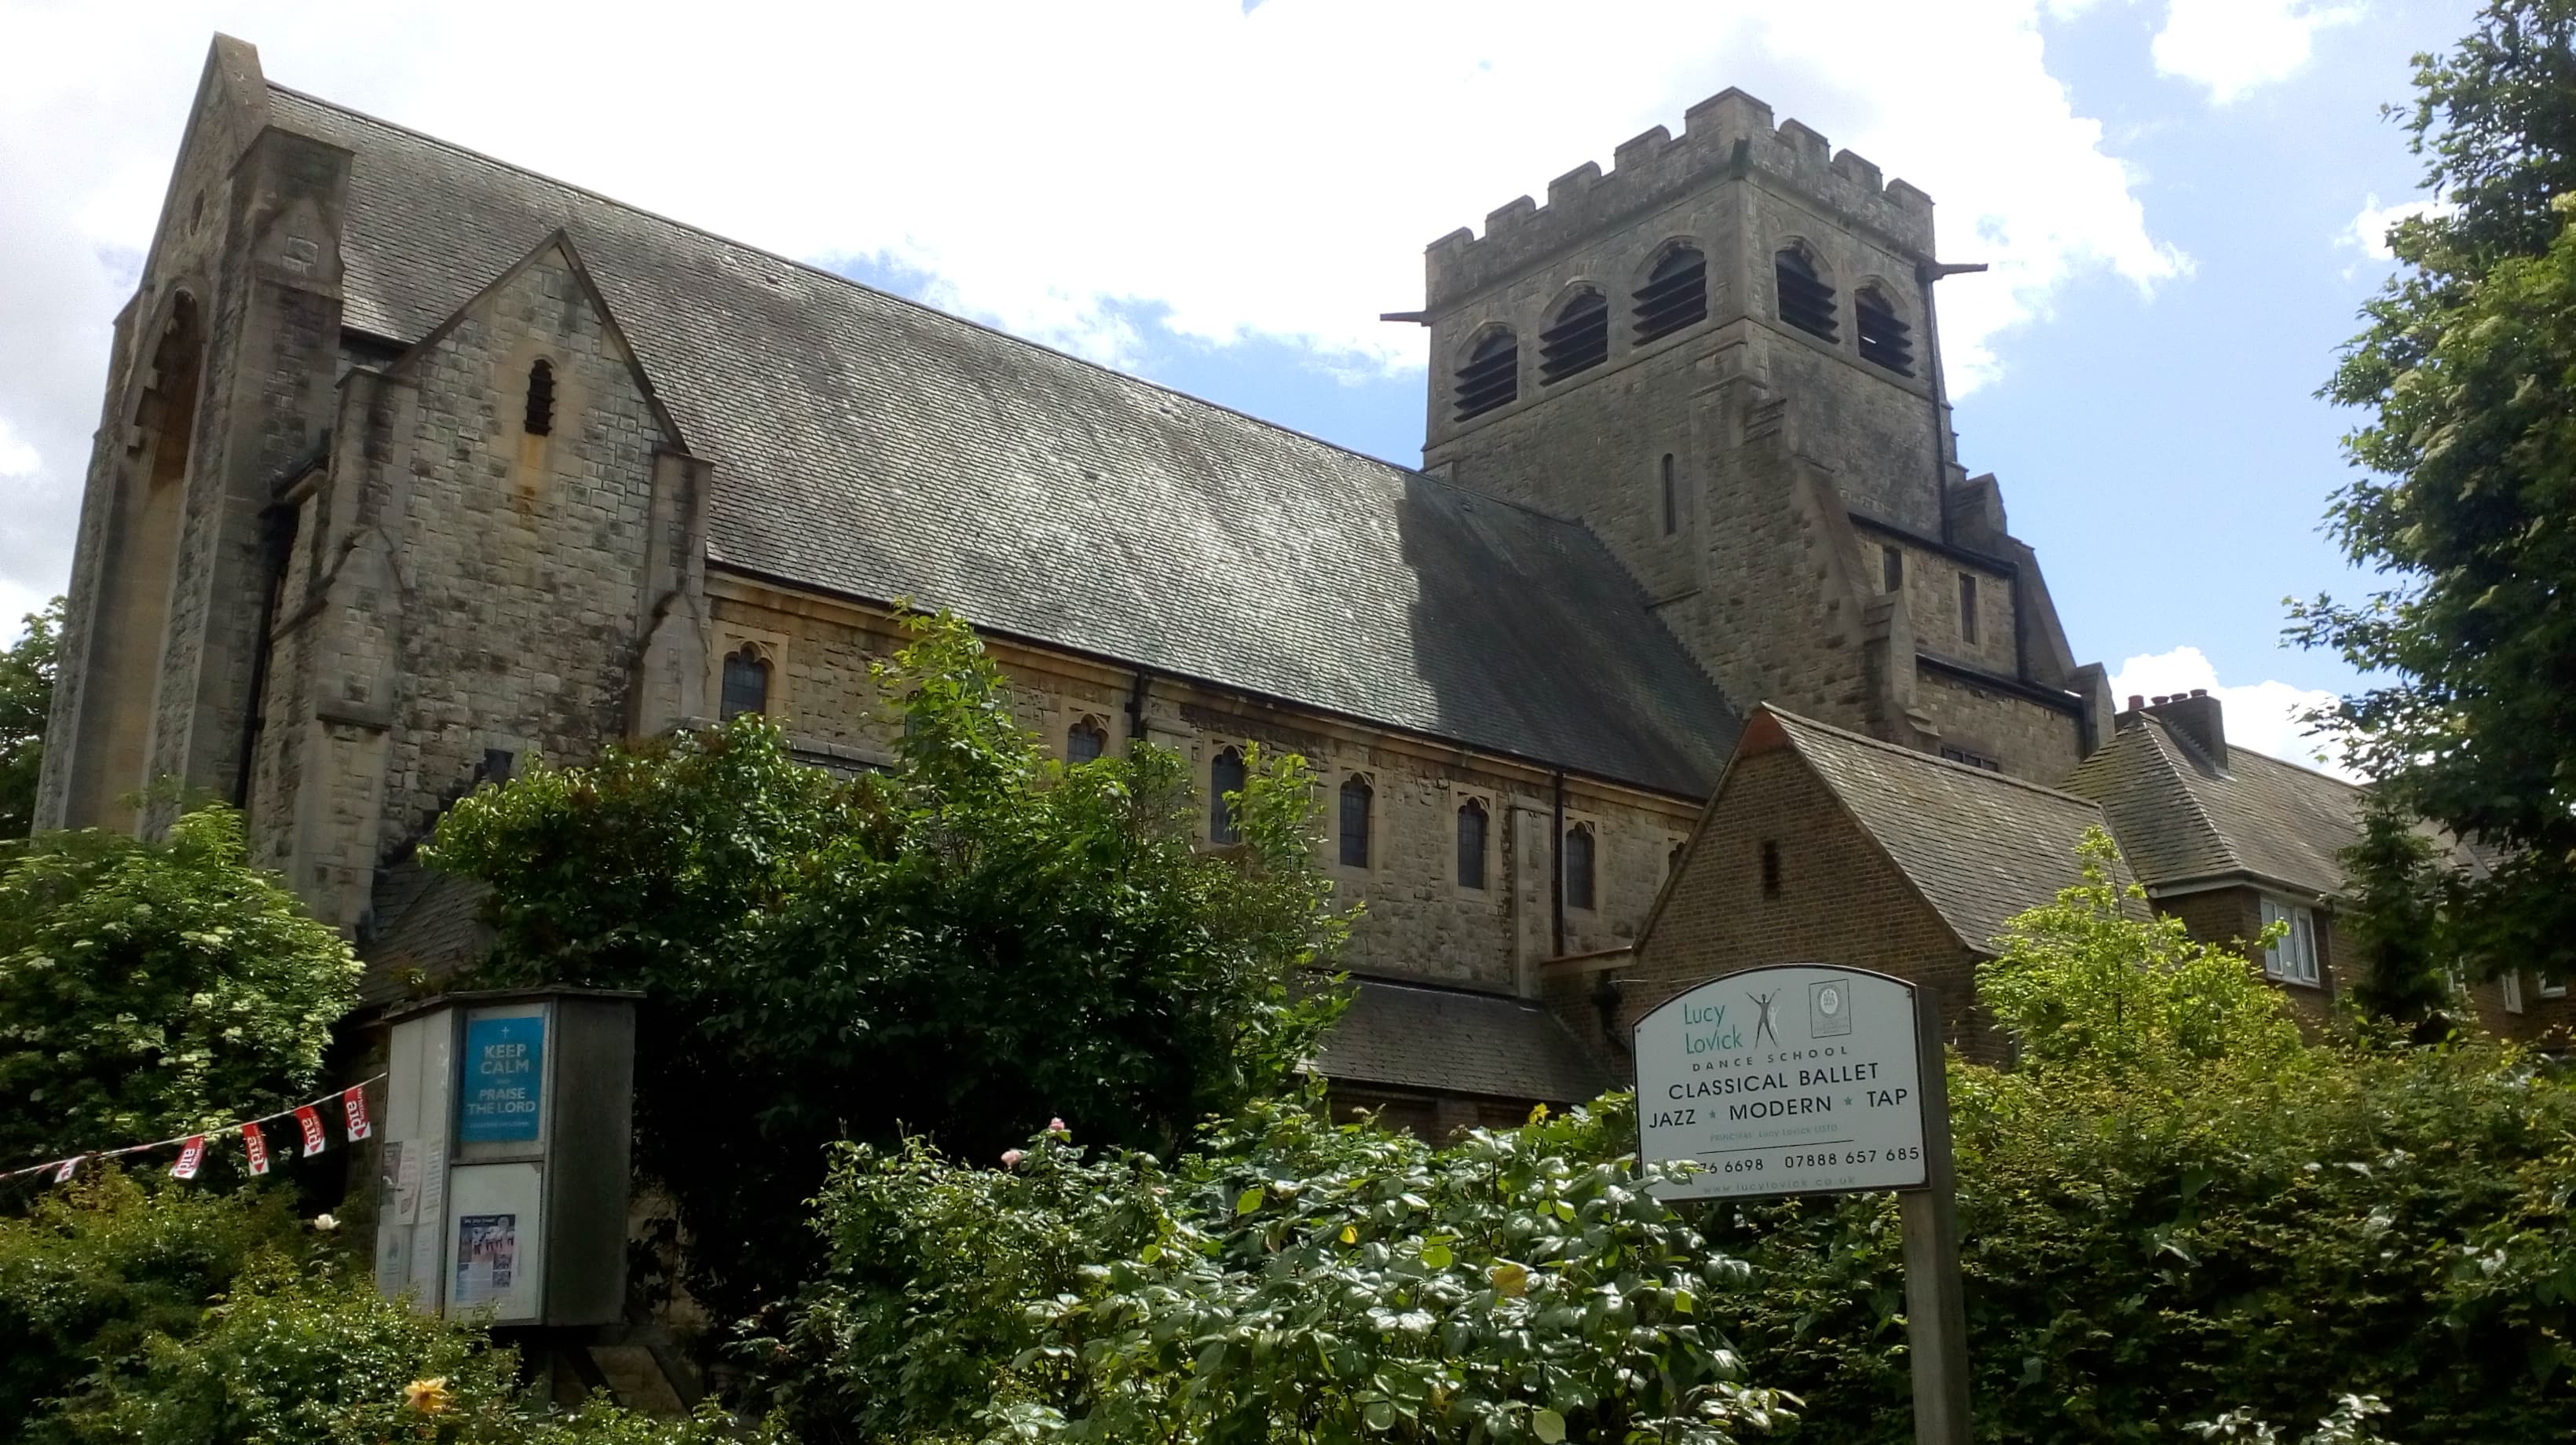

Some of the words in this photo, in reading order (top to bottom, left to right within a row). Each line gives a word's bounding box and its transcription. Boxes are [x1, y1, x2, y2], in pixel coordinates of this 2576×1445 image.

[1684, 1003, 1725, 1027] Lucy
[485, 1044, 526, 1058] KEEP
[1685, 1024, 1744, 1055] Lovick
[481, 1060, 529, 1074] CALM
[1692, 1056, 1753, 1072] DANCE
[1768, 1046, 1848, 1063] SCHOOL
[1668, 1073, 1788, 1099] CLASSICAL
[1799, 1063, 1879, 1086] BALLET
[479, 1088, 526, 1100] PRAISE
[346, 1101, 366, 1131] aid
[467, 1103, 496, 1114] THE
[497, 1101, 536, 1113] LORD
[1649, 1109, 1696, 1129] JAZZ
[1729, 1096, 1831, 1121] MODERN
[1867, 1088, 1908, 1107] TAP
[1725, 1159, 1764, 1172] 6698
[1784, 1153, 1837, 1169] 07888
[1846, 1151, 1877, 1164] 657
[1886, 1147, 1919, 1161] 685
